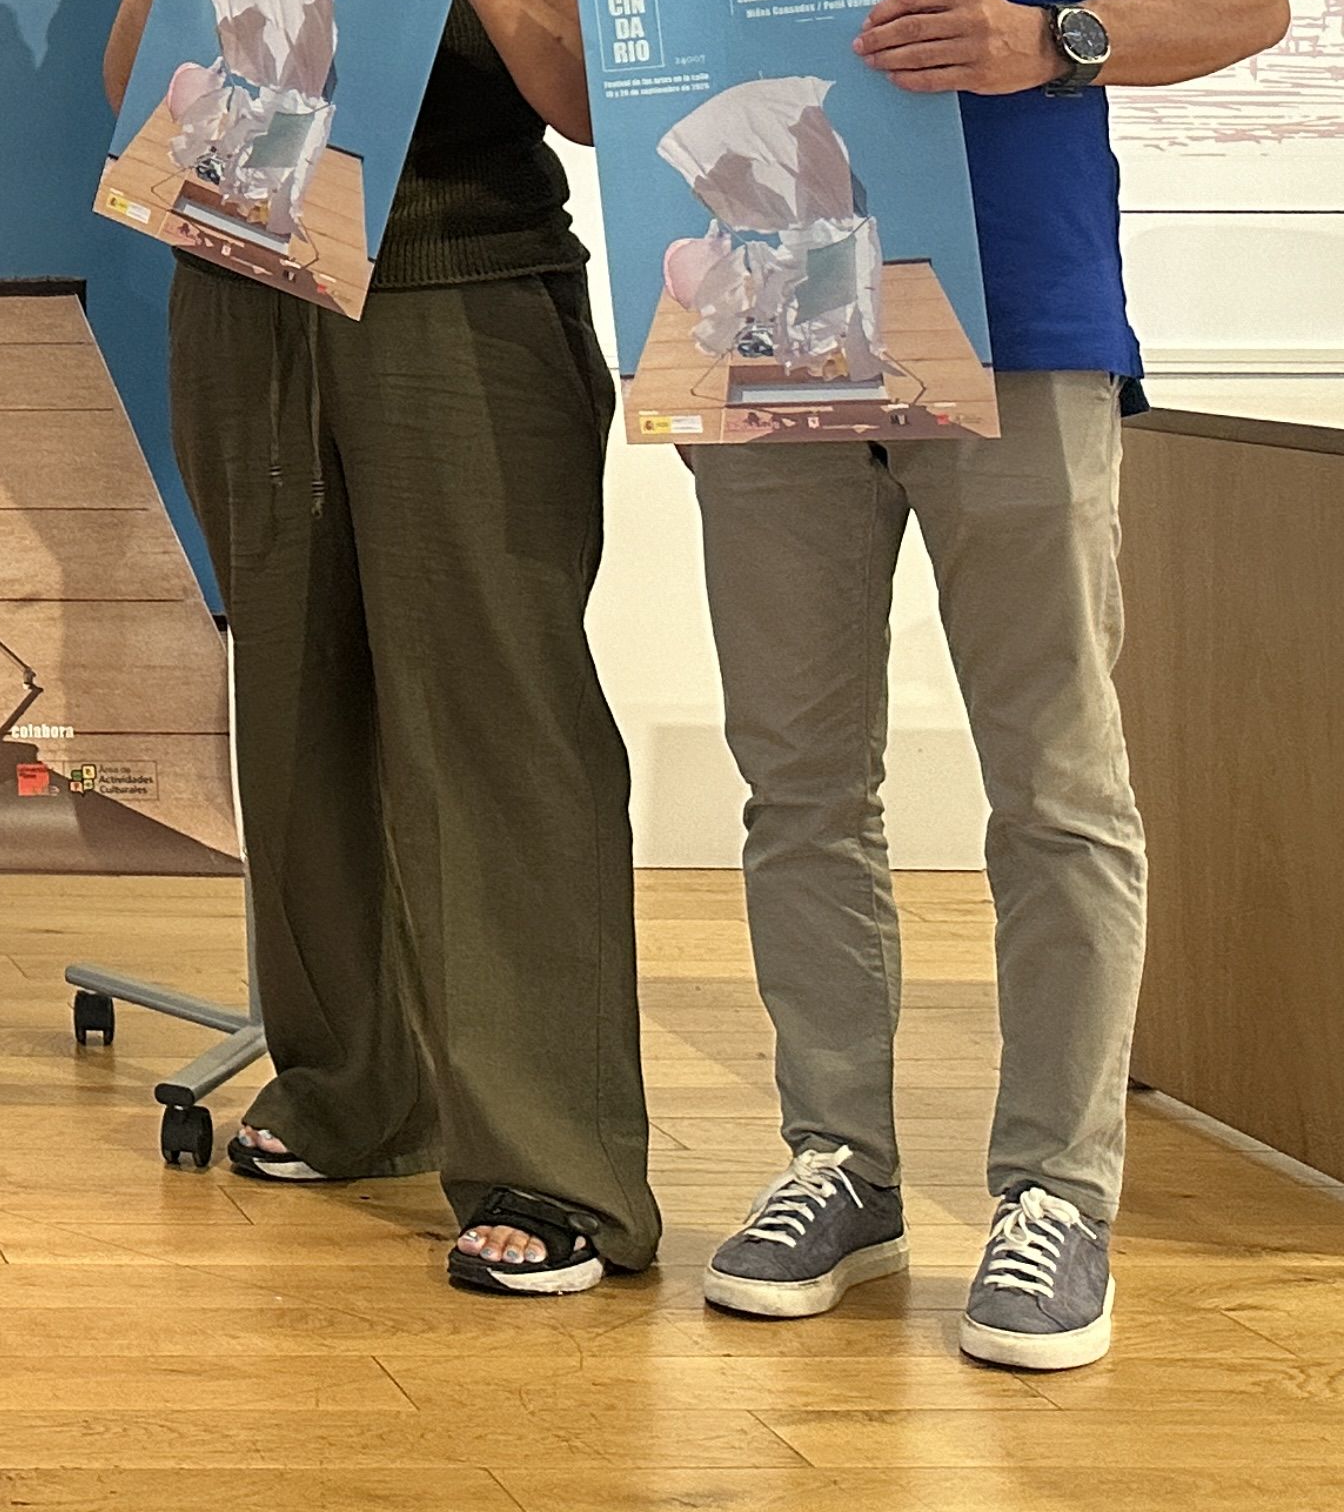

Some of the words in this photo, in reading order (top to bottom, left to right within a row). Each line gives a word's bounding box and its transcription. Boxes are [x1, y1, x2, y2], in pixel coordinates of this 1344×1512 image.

[615, 16, 645, 40] DA
[613, 39, 650, 64] RIO
[11, 723, 75, 739] colabora
